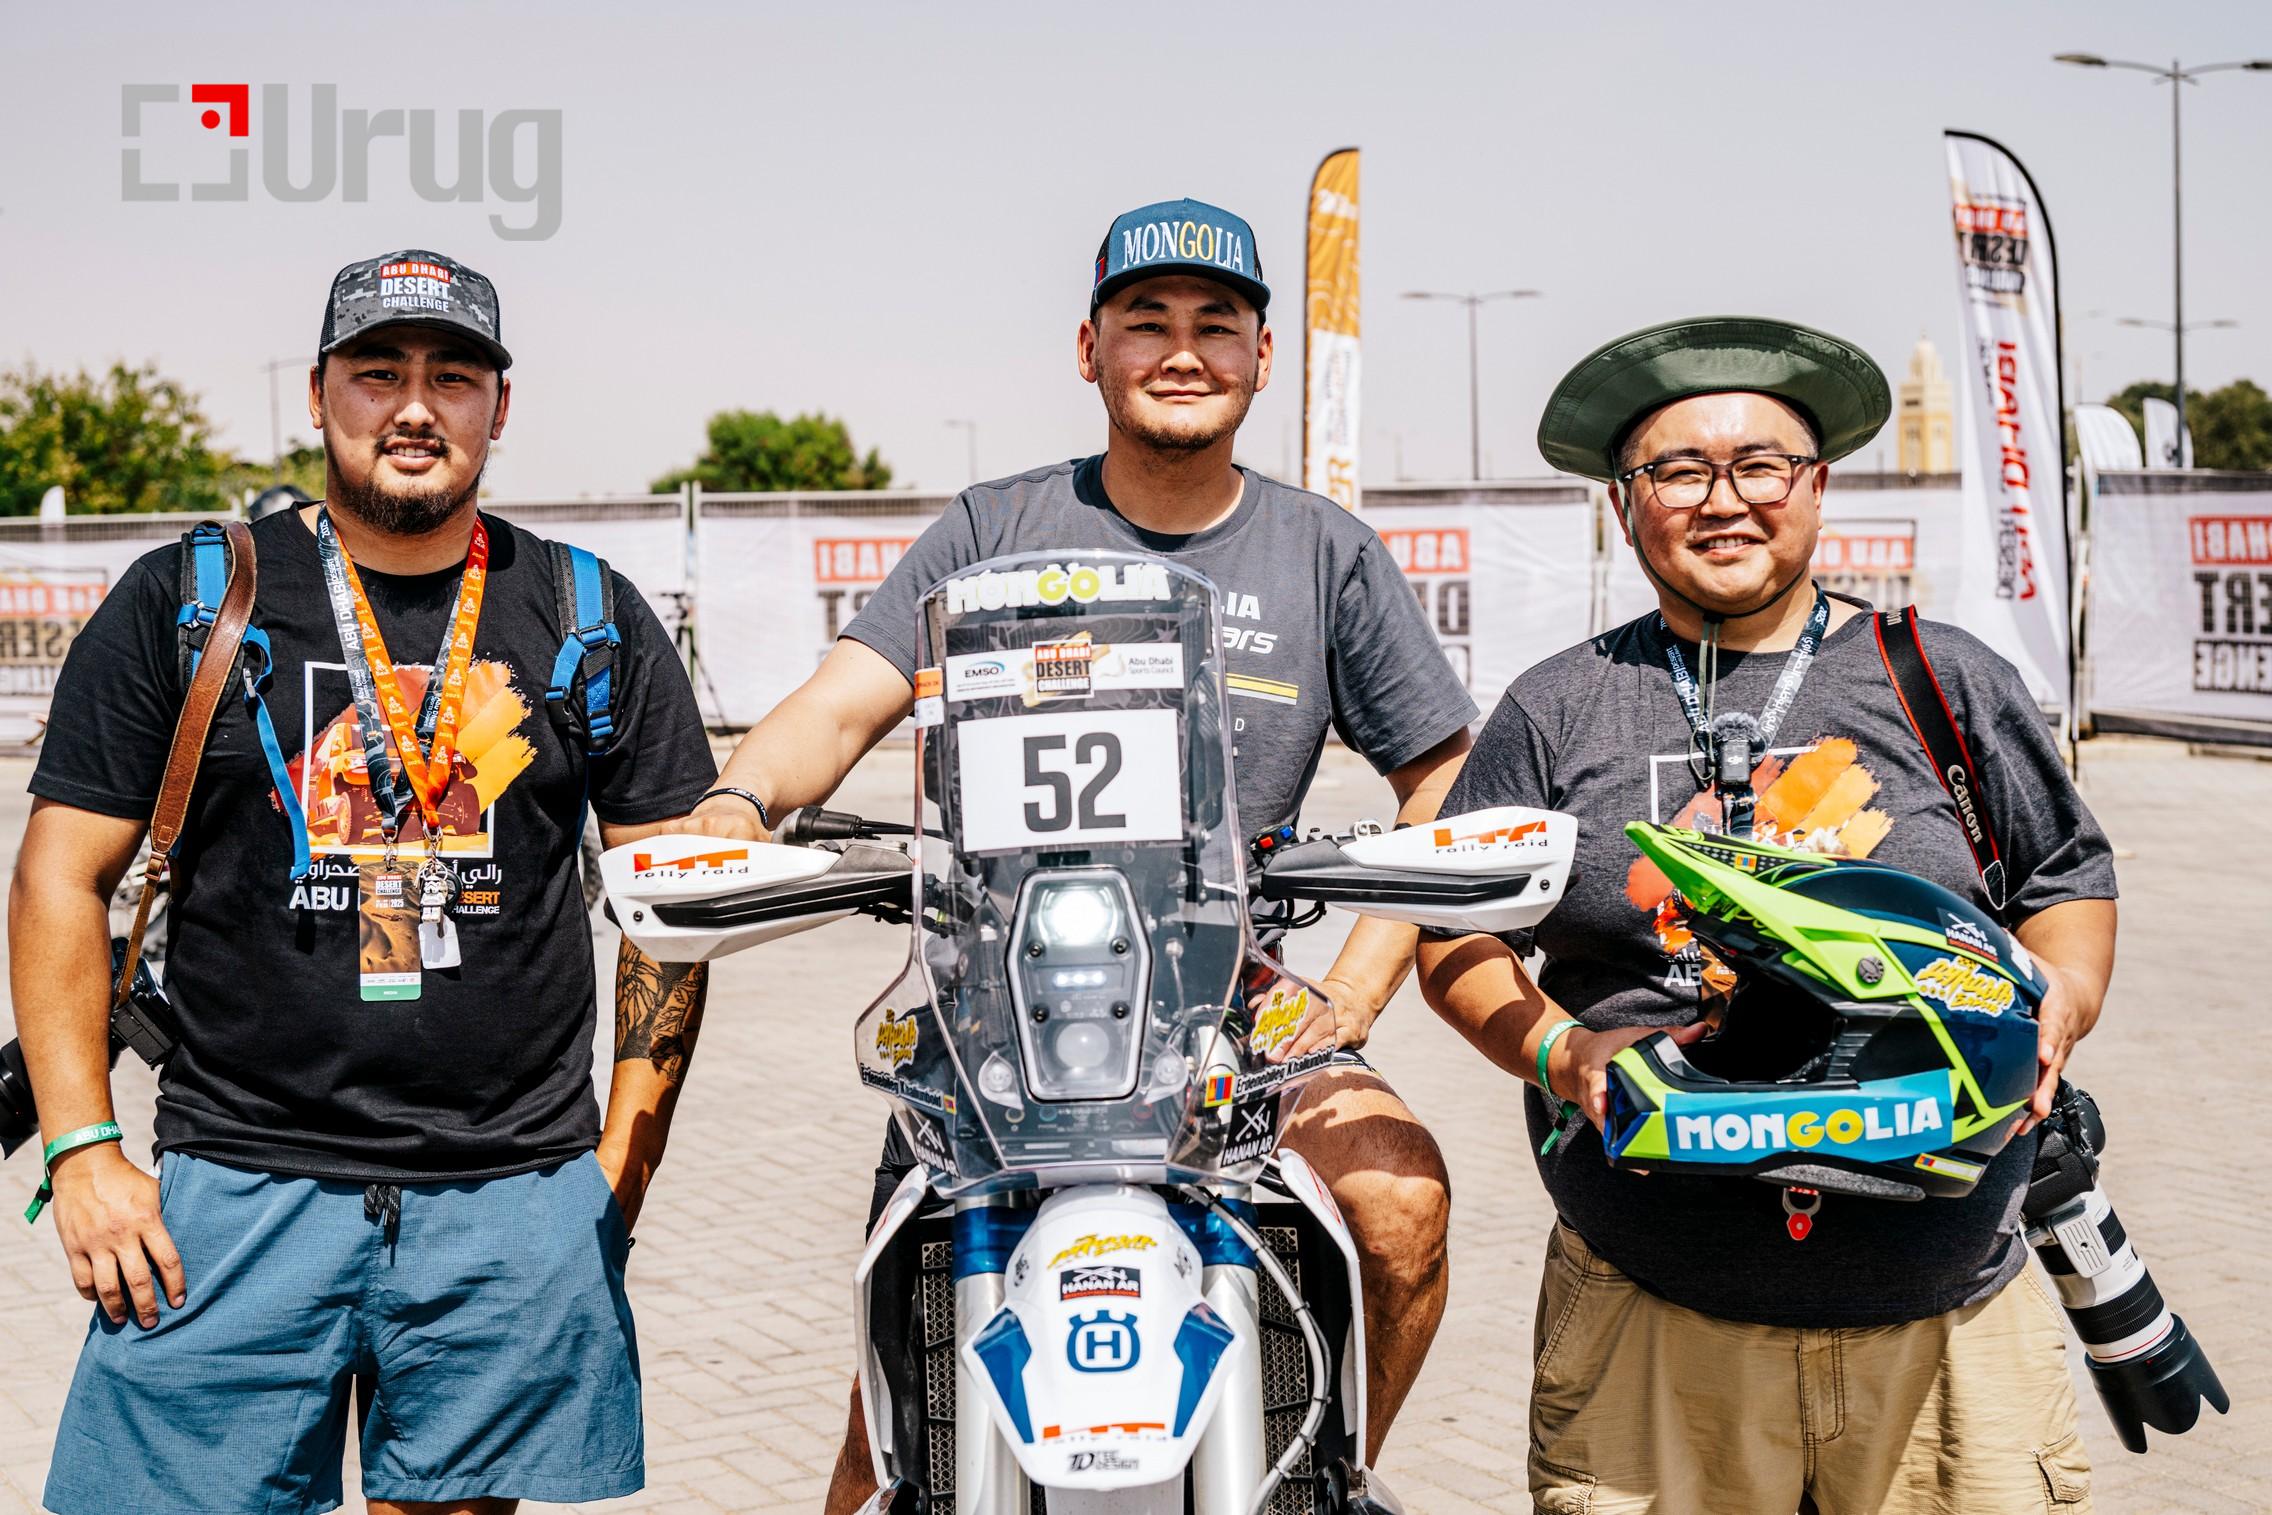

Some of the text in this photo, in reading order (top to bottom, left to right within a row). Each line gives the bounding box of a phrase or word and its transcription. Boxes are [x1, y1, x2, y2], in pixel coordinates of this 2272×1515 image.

[1122, 221, 1244, 272] MONGOLIA
[382, 263, 449, 281] ABU DHABI
[380, 276, 450, 299] DESERT
[382, 296, 450, 313] CHALLENGE
[947, 564, 1172, 614] MONGOLIA
[334, 583, 360, 650] ABU DHABI
[1221, 591, 1261, 620] IA
[964, 667, 999, 678] EMSO
[1036, 660, 1091, 678] DESERT
[1129, 656, 1173, 666] Abu Dhabi
[1023, 731, 1127, 833] 52
[1947, 763, 1983, 844] Canon
[461, 860, 502, 888] رالي
[702, 866, 748, 875] raid
[288, 886, 350, 911] ABU
[76, 1129, 99, 1142] ABU
[1675, 1096, 1943, 1151] MONGOLIA
[1223, 1134, 1274, 1166] HANAN AR
[1062, 1279, 1139, 1294] HANAN AR
